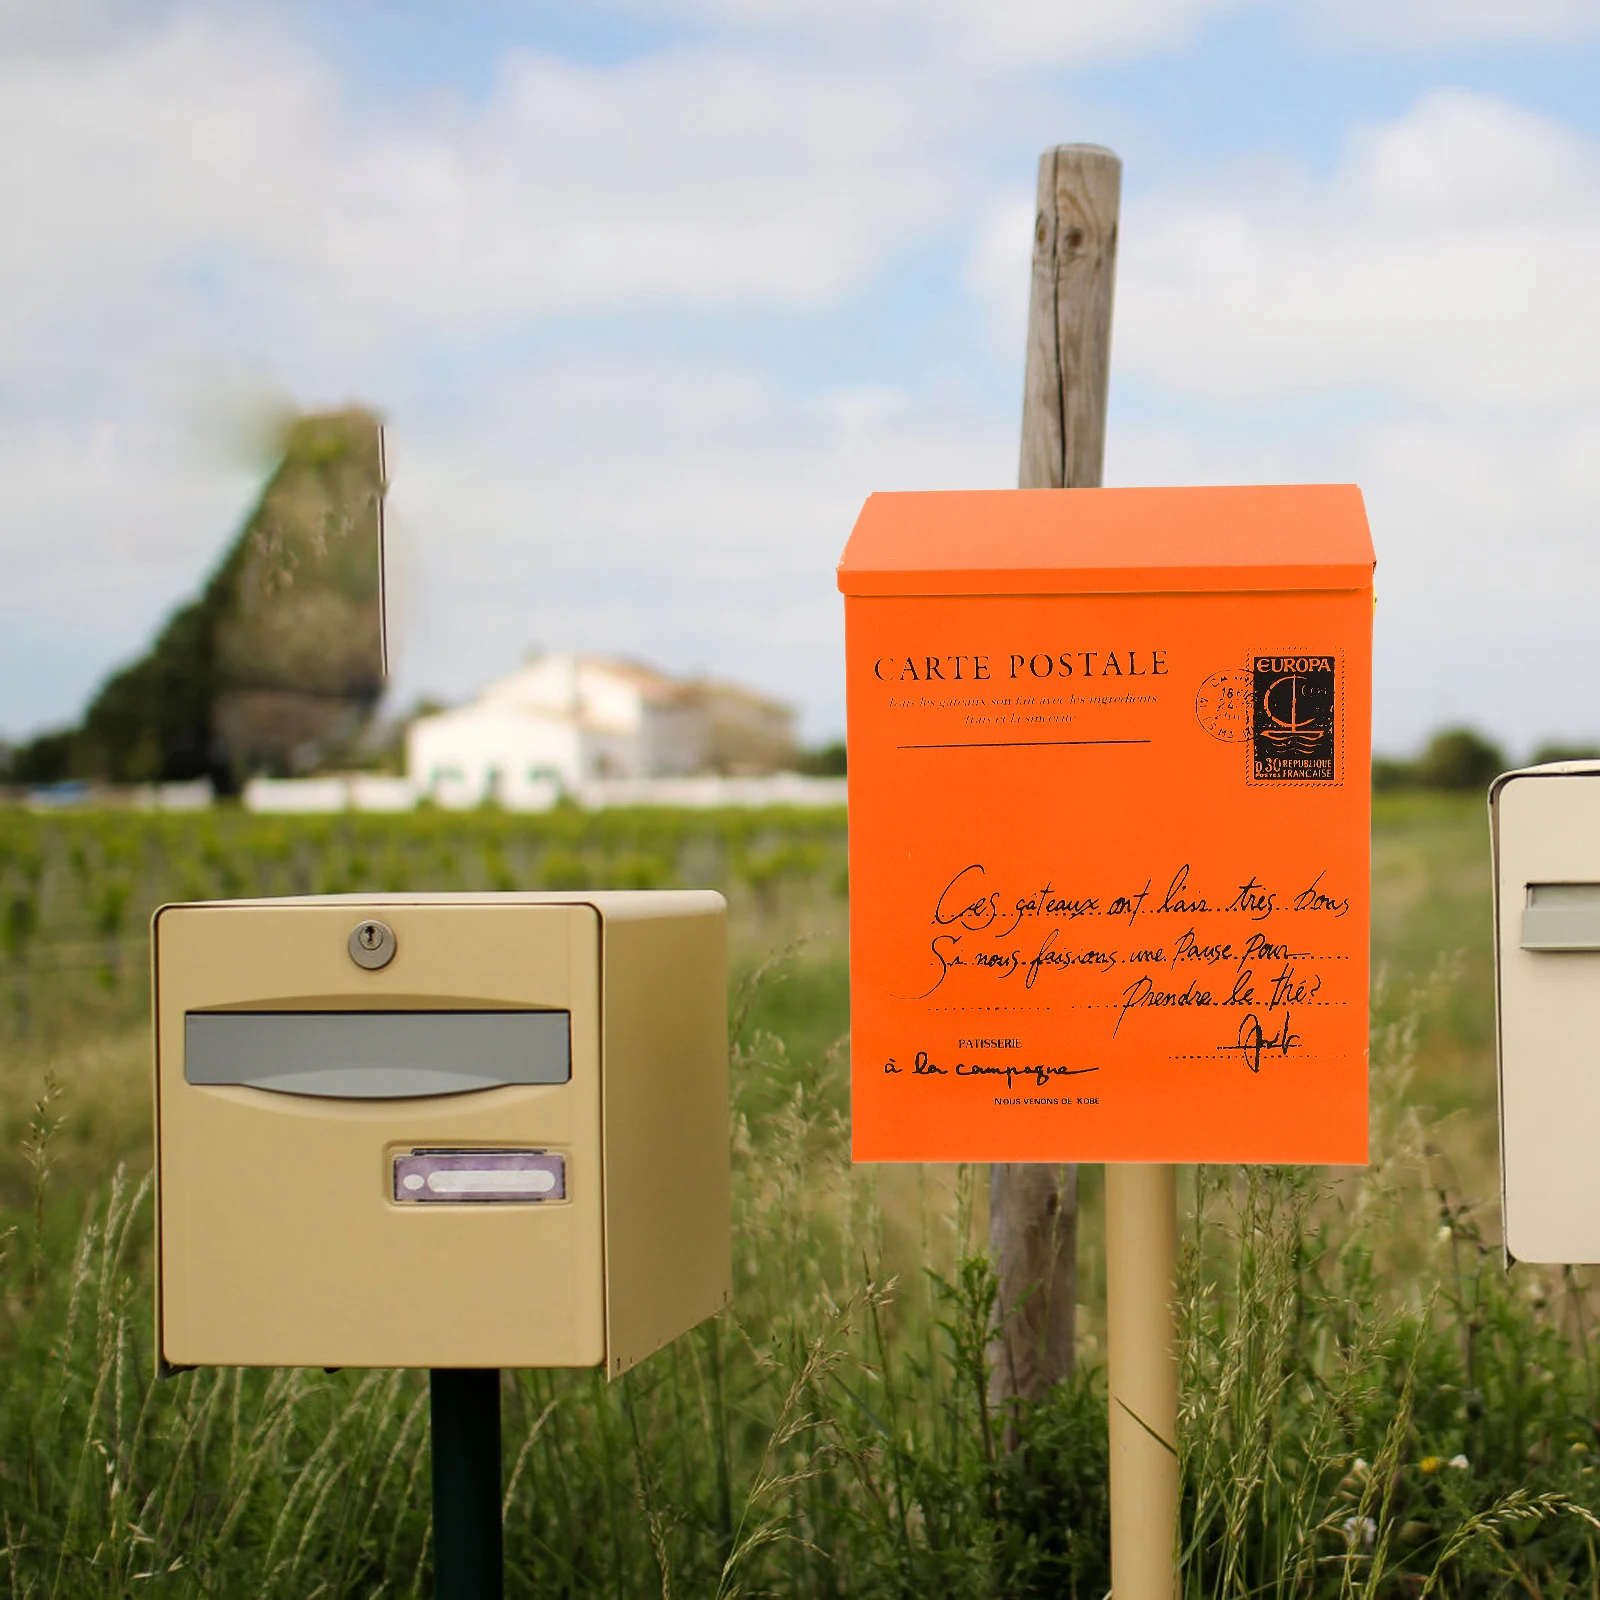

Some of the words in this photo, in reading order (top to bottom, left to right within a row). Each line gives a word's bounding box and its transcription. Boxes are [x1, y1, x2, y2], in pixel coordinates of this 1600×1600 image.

[875, 656, 991, 681] CARTE
[1009, 651, 1169, 678] POSTALE
[1256, 658, 1331, 673] EUROPA
[1283, 759, 1332, 768] REPUBLIQUE
[934, 864, 1000, 931] Ces
[995, 882, 1099, 938] gâteaux
[1106, 879, 1151, 927] ont
[1229, 876, 1277, 921] très
[975, 950, 1020, 978] nous
[1026, 929, 1118, 989] faisions
[1129, 948, 1166, 963] une
[1222, 970, 1255, 1007] le
[958, 1038, 1023, 1049] PATISSERIE
[885, 1058, 902, 1073] à
[912, 1051, 948, 1075] la
[955, 1063, 1100, 1089] campagne
